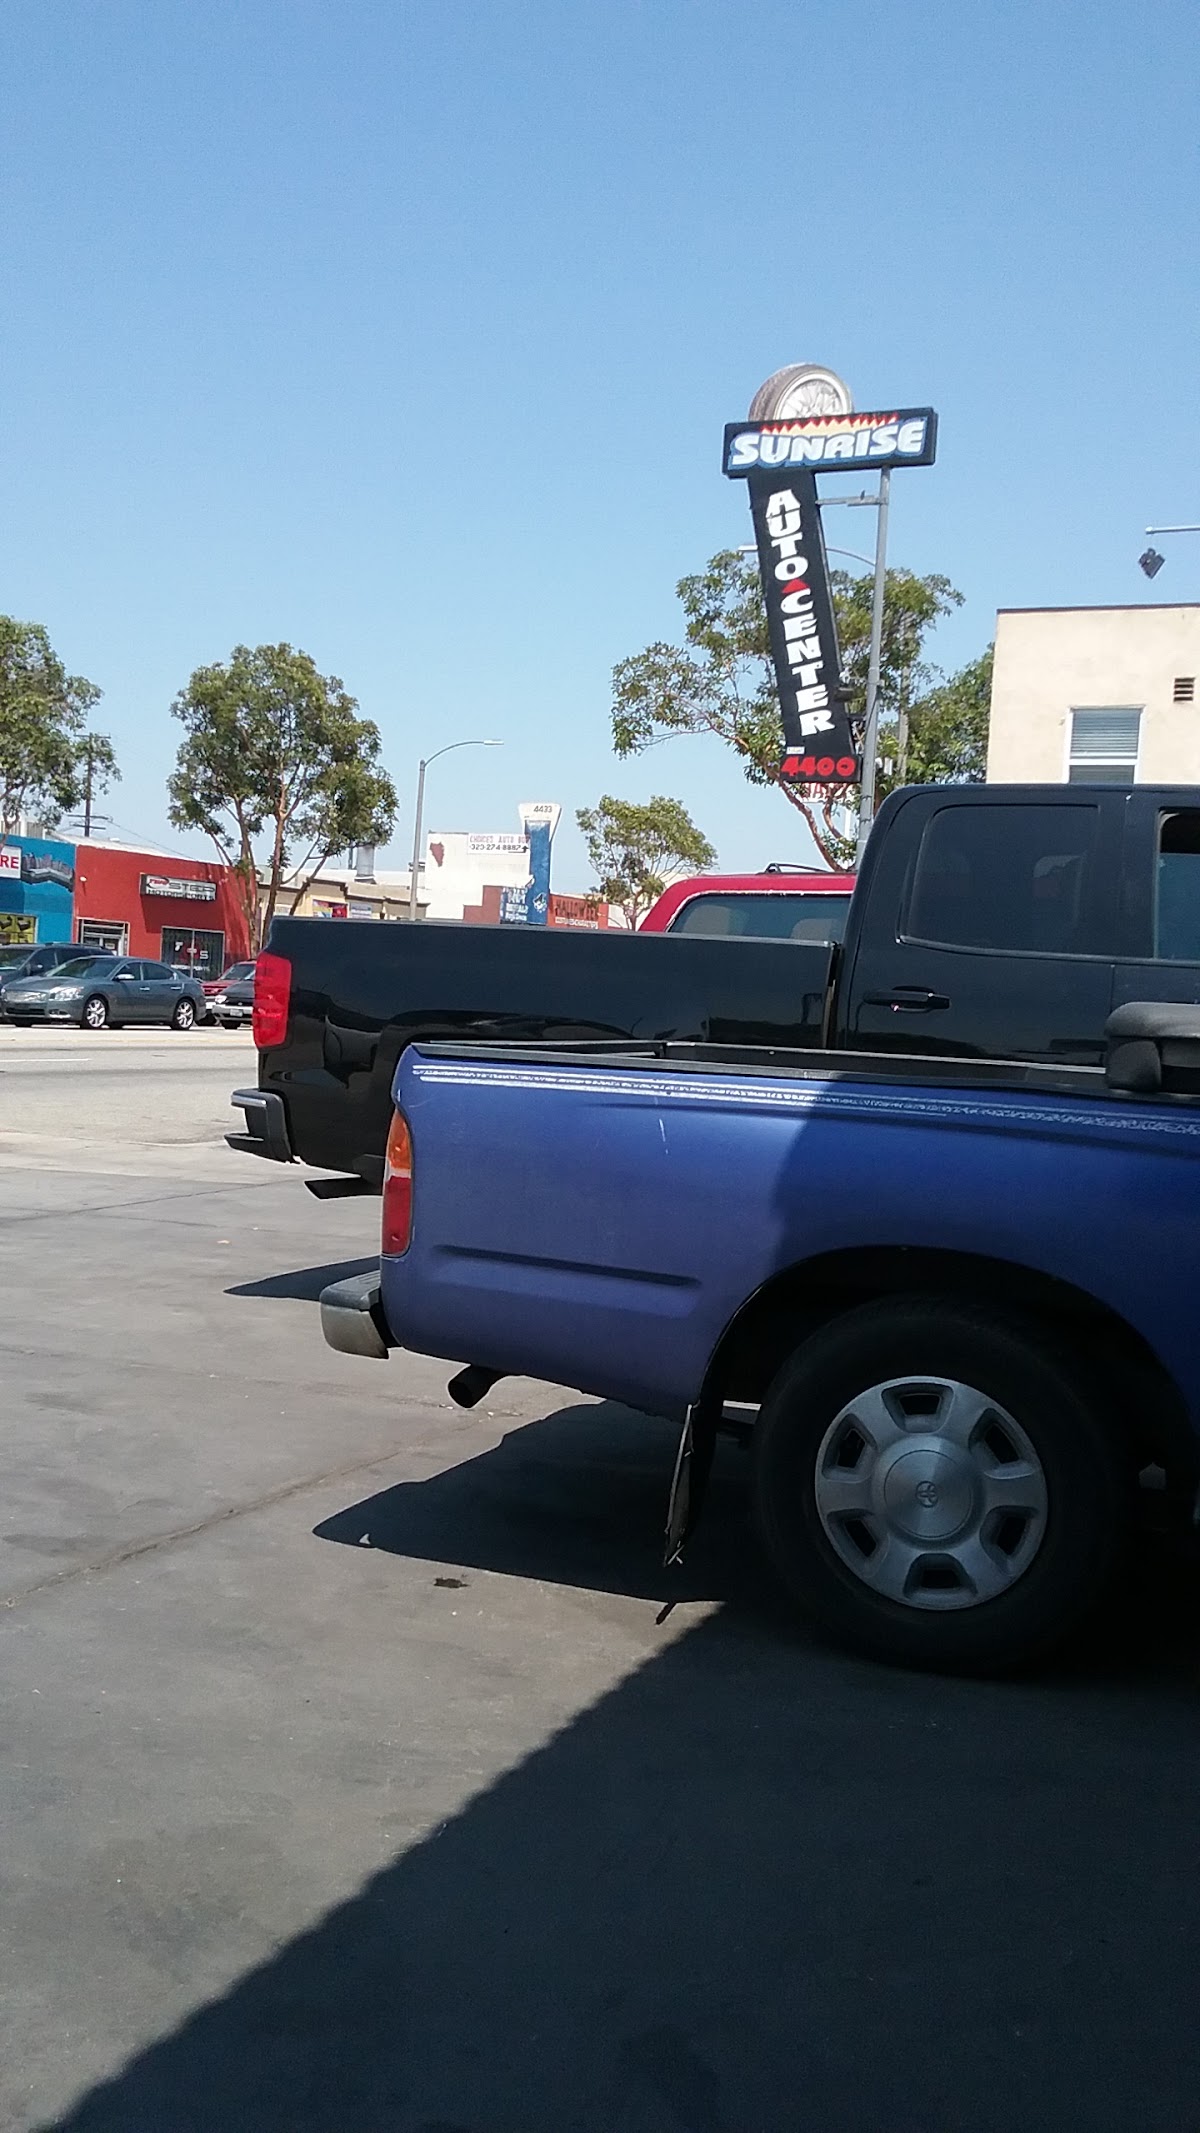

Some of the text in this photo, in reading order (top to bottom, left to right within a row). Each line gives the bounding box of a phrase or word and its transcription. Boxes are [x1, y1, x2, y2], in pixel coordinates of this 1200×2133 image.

[730, 419, 926, 466] SUNRISE
[765, 489, 808, 581] AUTO
[780, 588, 835, 736] CENTER
[781, 756, 856, 777] 4400
[533, 805, 553, 813] 4433
